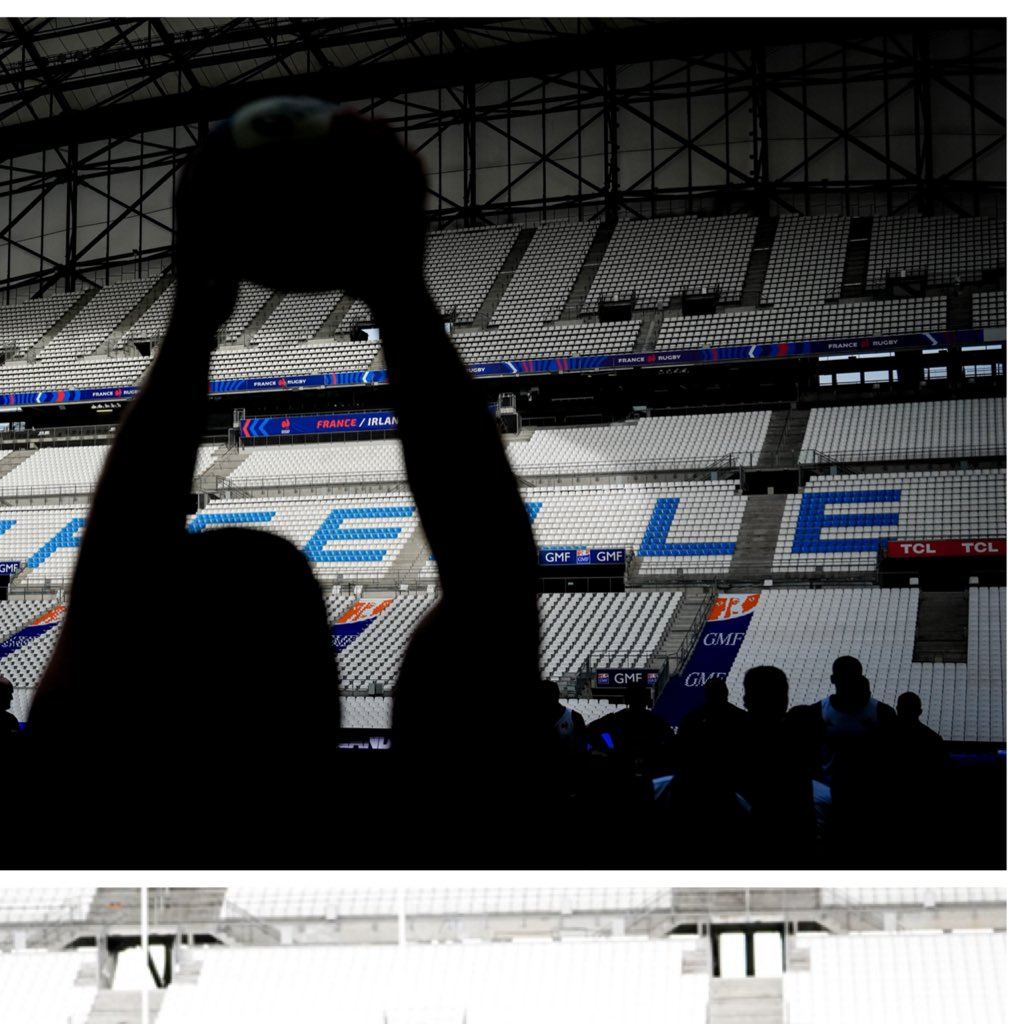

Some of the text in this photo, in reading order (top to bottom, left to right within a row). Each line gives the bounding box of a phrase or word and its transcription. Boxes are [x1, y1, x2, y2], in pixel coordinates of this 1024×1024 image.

[316, 418, 357, 429] FRANCE
[367, 416, 398, 427] IRLAN
[900, 542, 998, 554] TCL TCL
[545, 552, 570, 563] GMF
[596, 551, 623, 562] GMF
[703, 632, 745, 646] GMF
[614, 672, 643, 684] GMF
